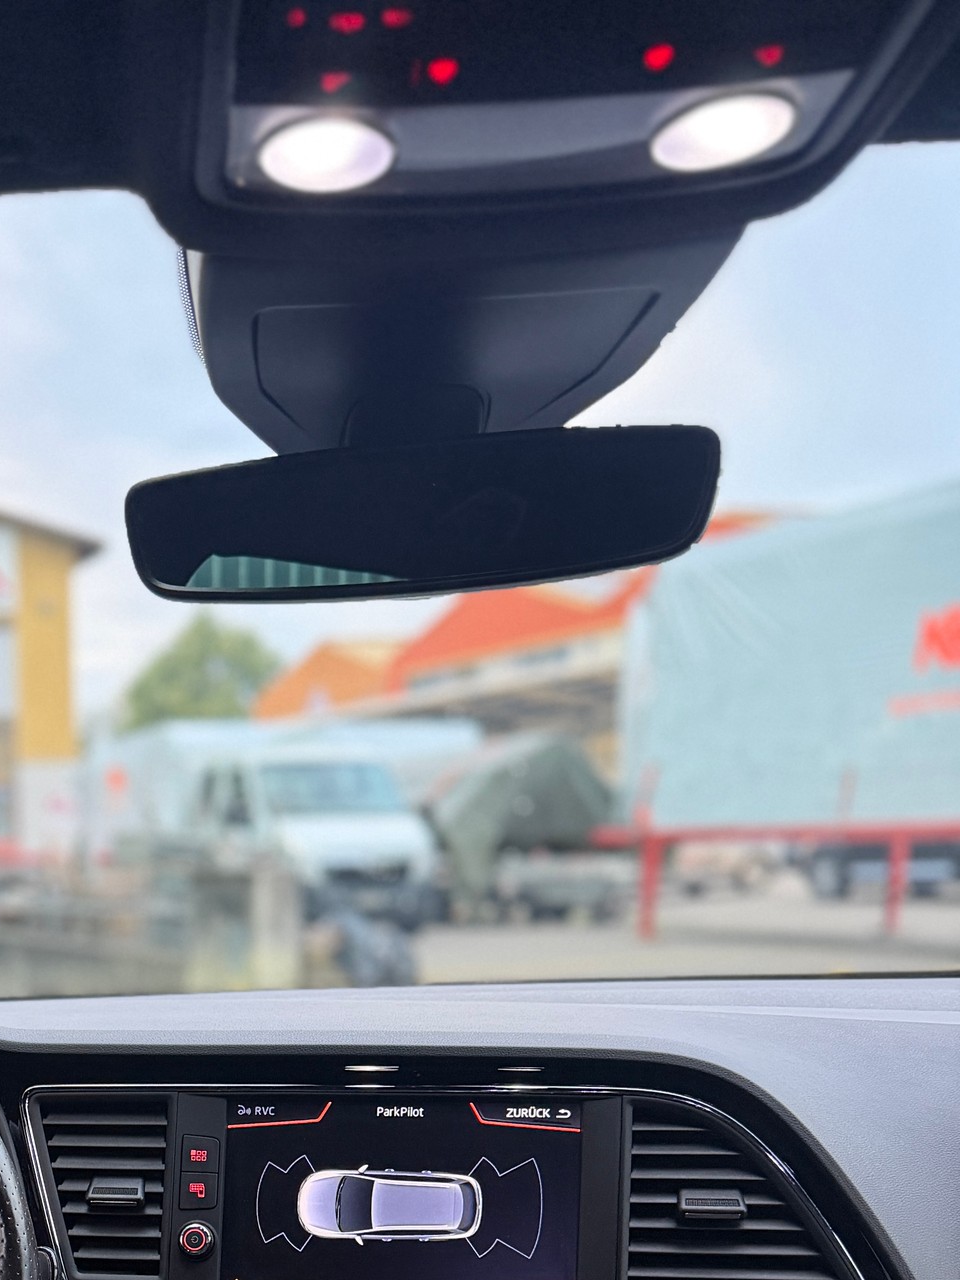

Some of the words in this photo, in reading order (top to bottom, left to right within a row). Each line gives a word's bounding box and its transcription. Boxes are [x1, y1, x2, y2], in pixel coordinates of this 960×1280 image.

[254, 1106, 275, 1116] RVC
[376, 1106, 425, 1118] ParkPilot
[506, 1105, 551, 1119] ZURÜCK
